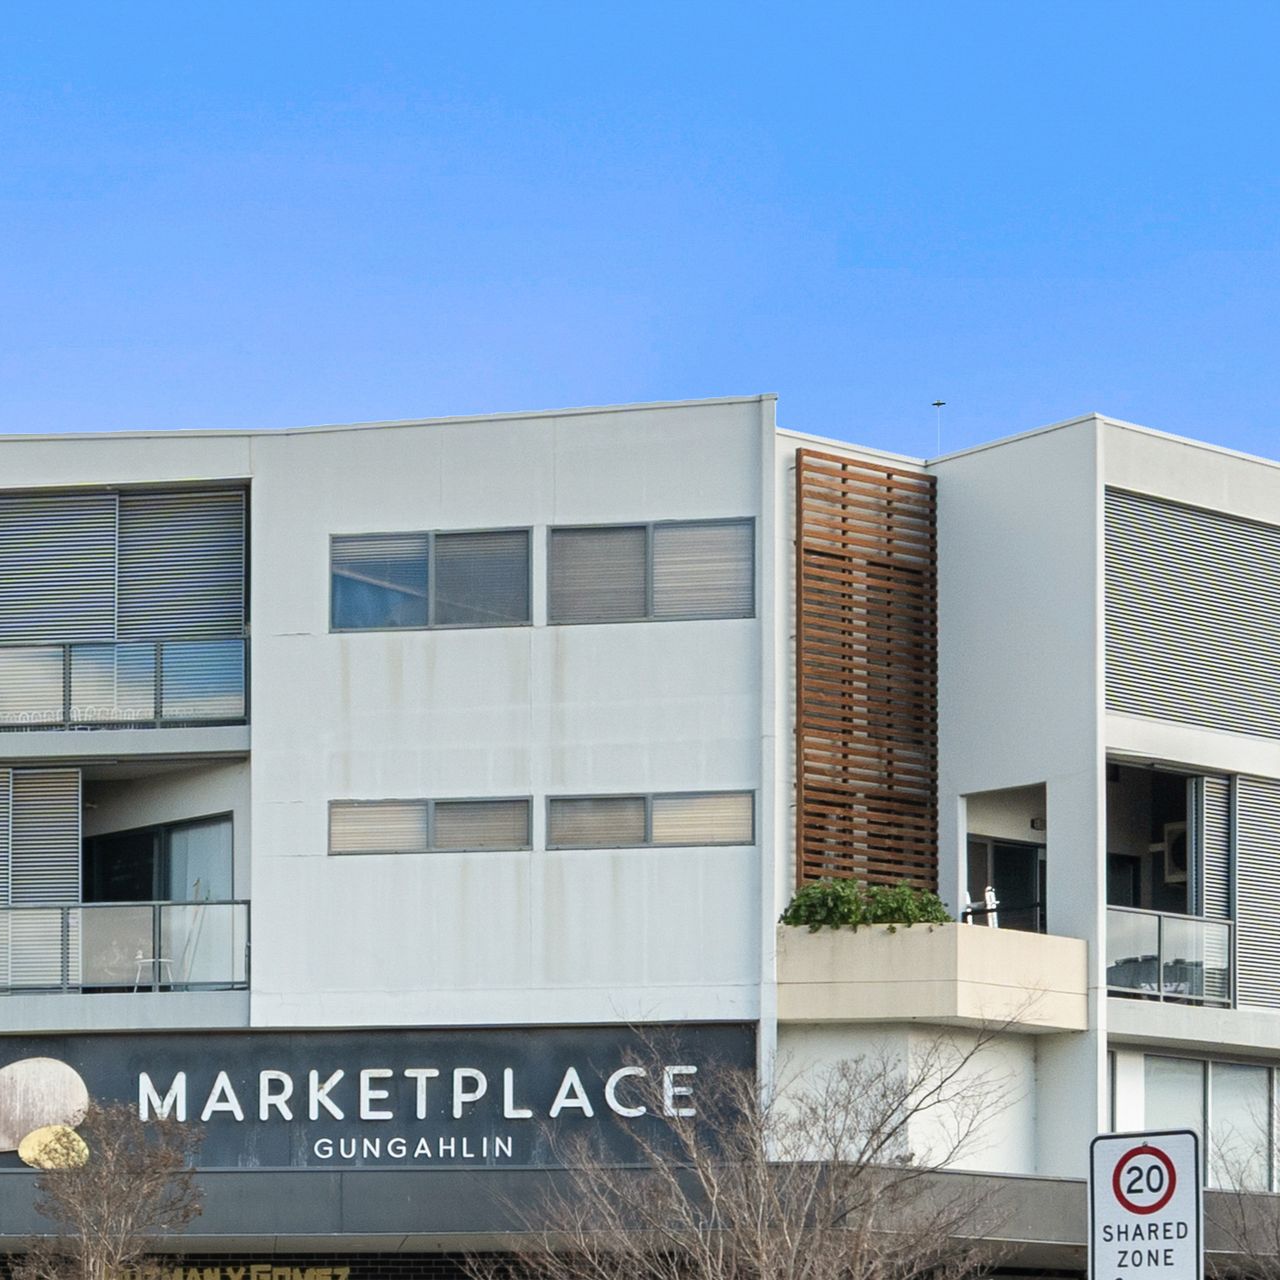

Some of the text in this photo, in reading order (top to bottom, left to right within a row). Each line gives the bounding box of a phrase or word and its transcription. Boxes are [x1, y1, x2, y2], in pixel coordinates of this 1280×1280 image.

[138, 1066, 698, 1122] MARKETPLACE
[313, 1135, 513, 1160] GUNGAHLIN
[1126, 1164, 1164, 1194] 20
[1102, 1221, 1188, 1243] SHARED
[1116, 1248, 1175, 1268] ZONE
